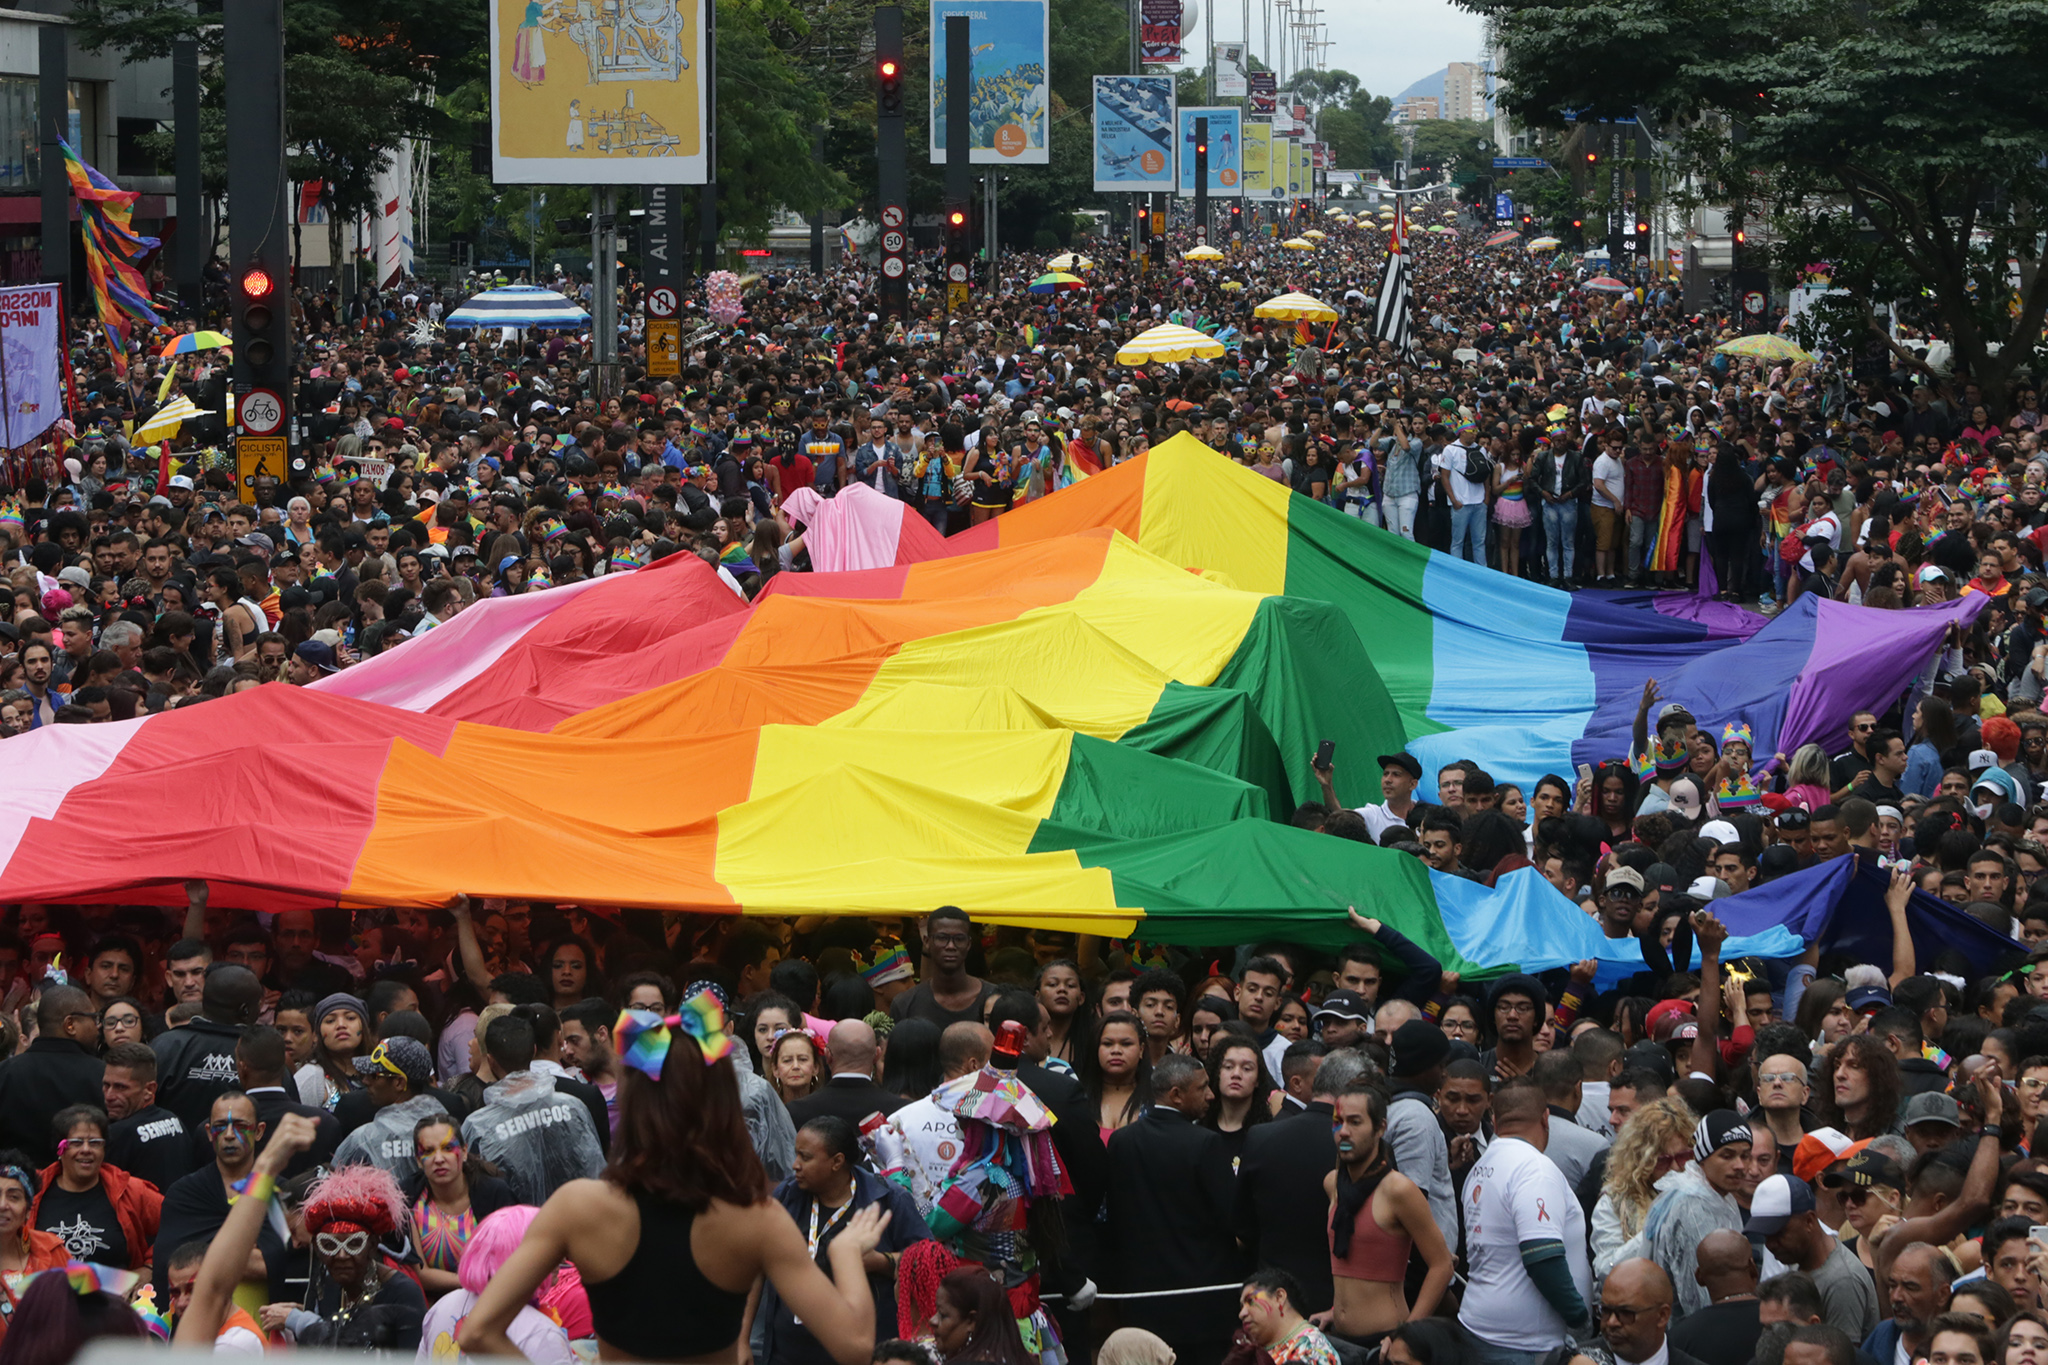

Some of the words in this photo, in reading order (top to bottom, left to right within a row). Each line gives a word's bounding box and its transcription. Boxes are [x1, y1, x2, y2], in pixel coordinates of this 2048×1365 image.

[966, 11, 988, 19] GERAL
[886, 235, 901, 246] 50
[650, 233, 668, 261] Al.
[240, 444, 283, 452] CICLISTA
[495, 1104, 572, 1141] SERVIÇOS
